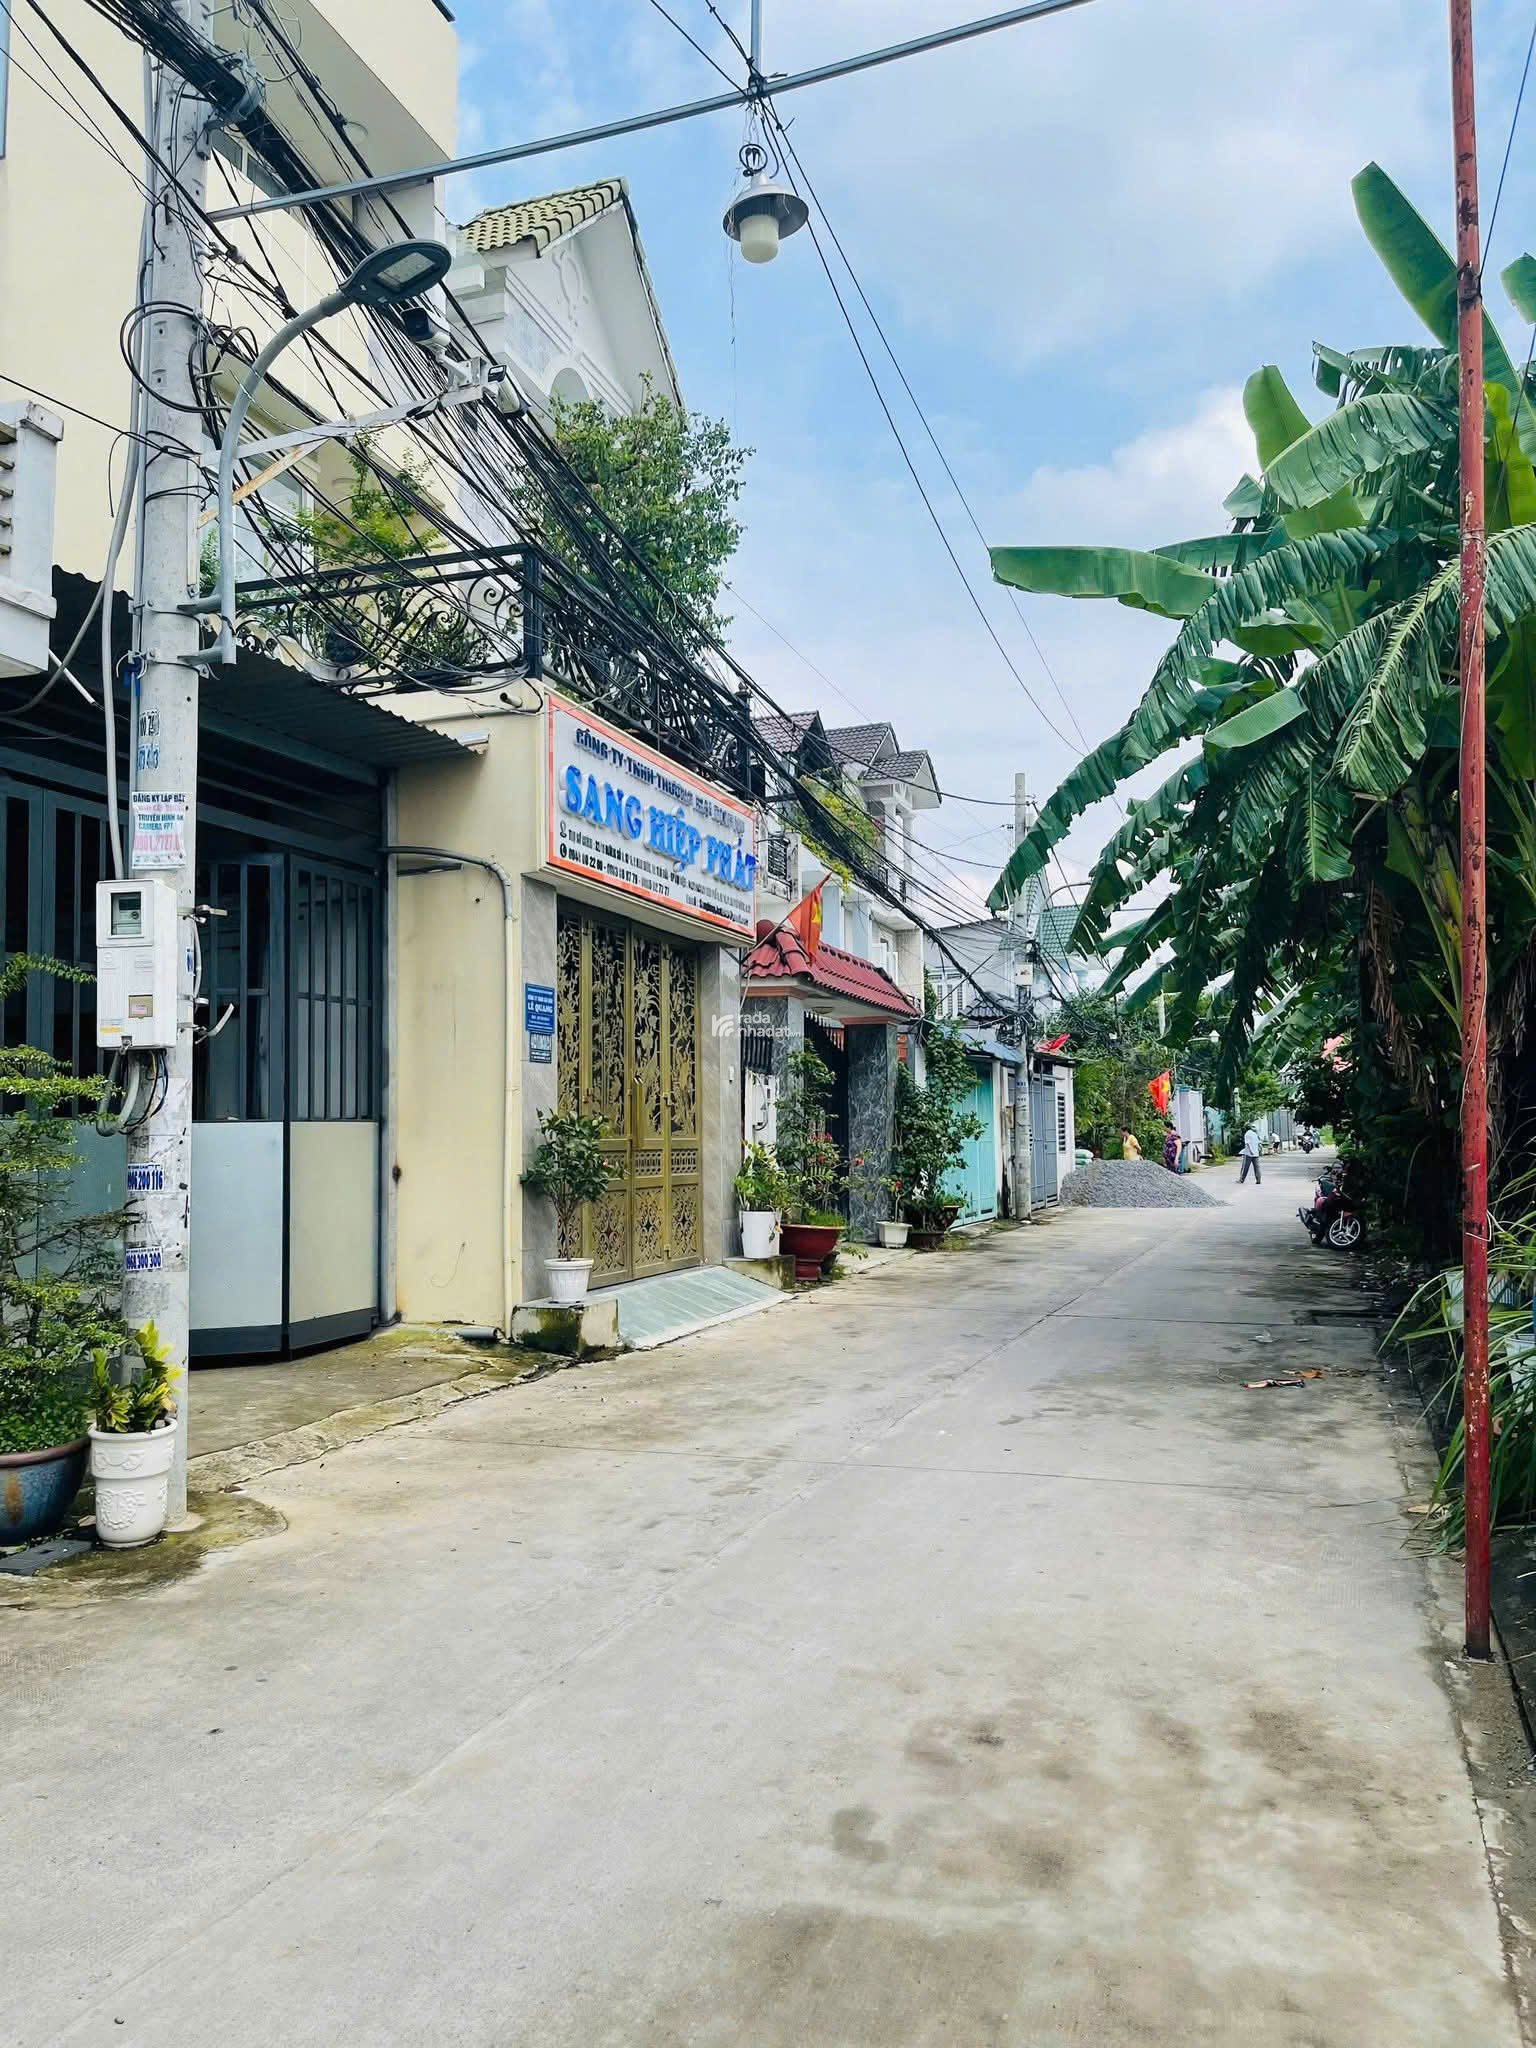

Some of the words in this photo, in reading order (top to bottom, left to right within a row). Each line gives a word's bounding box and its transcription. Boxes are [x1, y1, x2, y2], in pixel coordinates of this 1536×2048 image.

[576, 728, 608, 760] CÔNG
[611, 747, 624, 767] TY
[566, 764, 643, 840] SANG
[649, 806, 701, 872] HIỆP
[706, 838, 757, 892] PHÁT
[151, 1170, 163, 1190] 116
[149, 1252, 161, 1268] 300
